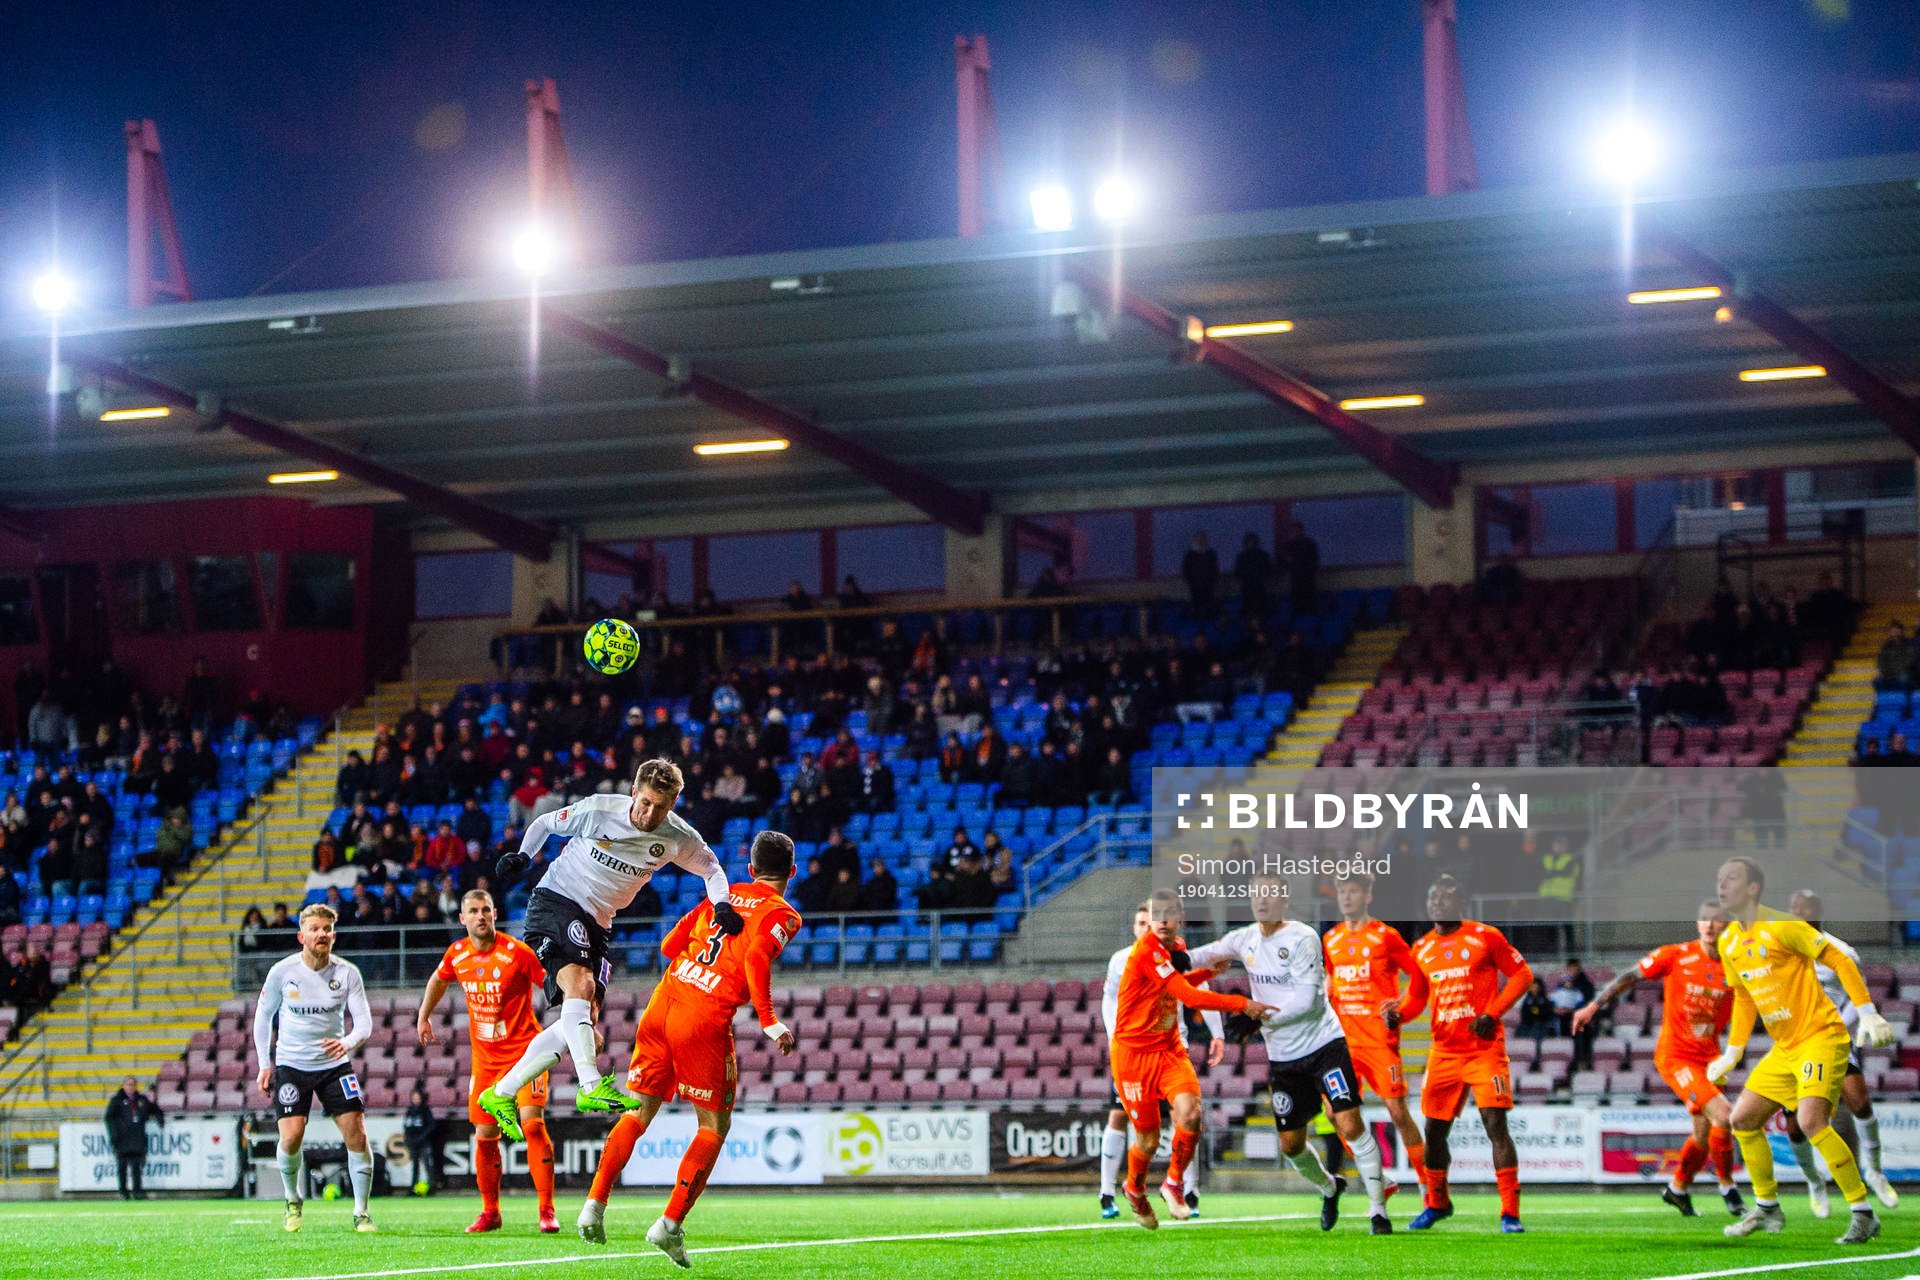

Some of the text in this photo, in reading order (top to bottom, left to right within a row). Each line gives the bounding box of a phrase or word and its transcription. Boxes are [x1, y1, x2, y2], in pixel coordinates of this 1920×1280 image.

[608, 640, 635, 653] SELECT
[696, 920, 729, 966] 3
[461, 980, 502, 993] SMART
[1801, 1062, 1824, 1082] 91
[887, 1117, 973, 1142] Ea VVS
[1006, 1121, 1052, 1158] One
[1053, 1120, 1082, 1158] of
[1084, 1120, 1105, 1158] th
[81, 1132, 192, 1156] SUNOLMS
[638, 1136, 758, 1161] outopu
